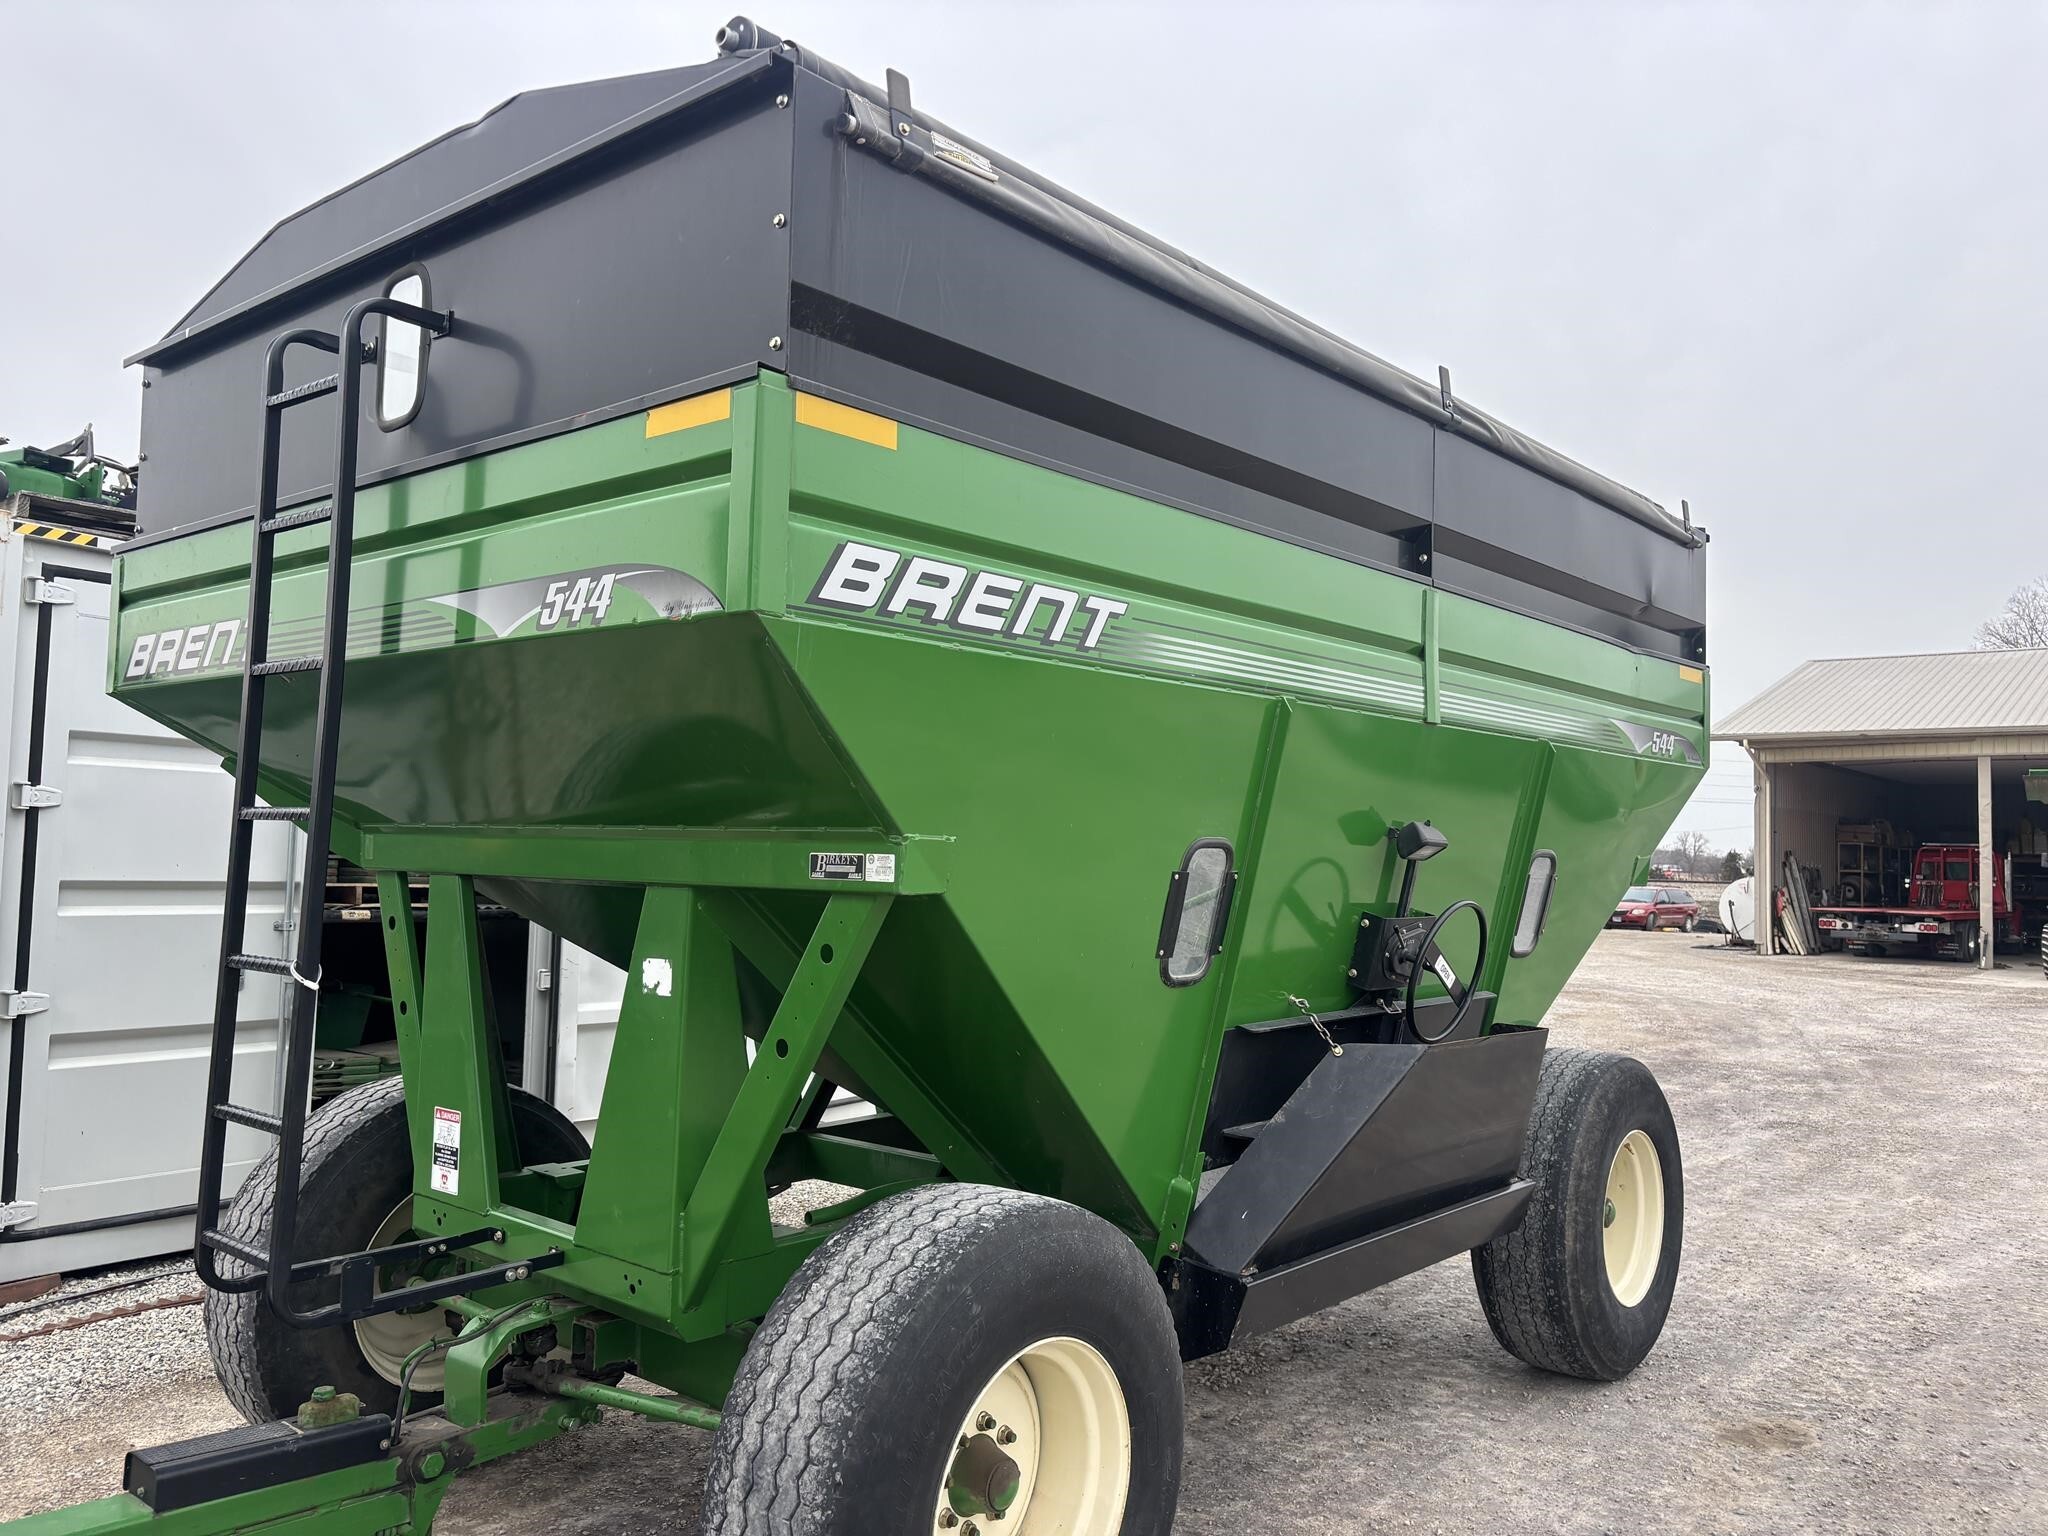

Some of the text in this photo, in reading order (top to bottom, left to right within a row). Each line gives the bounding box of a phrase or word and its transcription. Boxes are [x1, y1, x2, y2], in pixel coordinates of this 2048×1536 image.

[539, 573, 616, 628] 544
[816, 540, 1128, 648] BRENT
[125, 617, 248, 679] BREN
[1651, 731, 1676, 756] 544
[441, 1109, 460, 1121] DANGER
